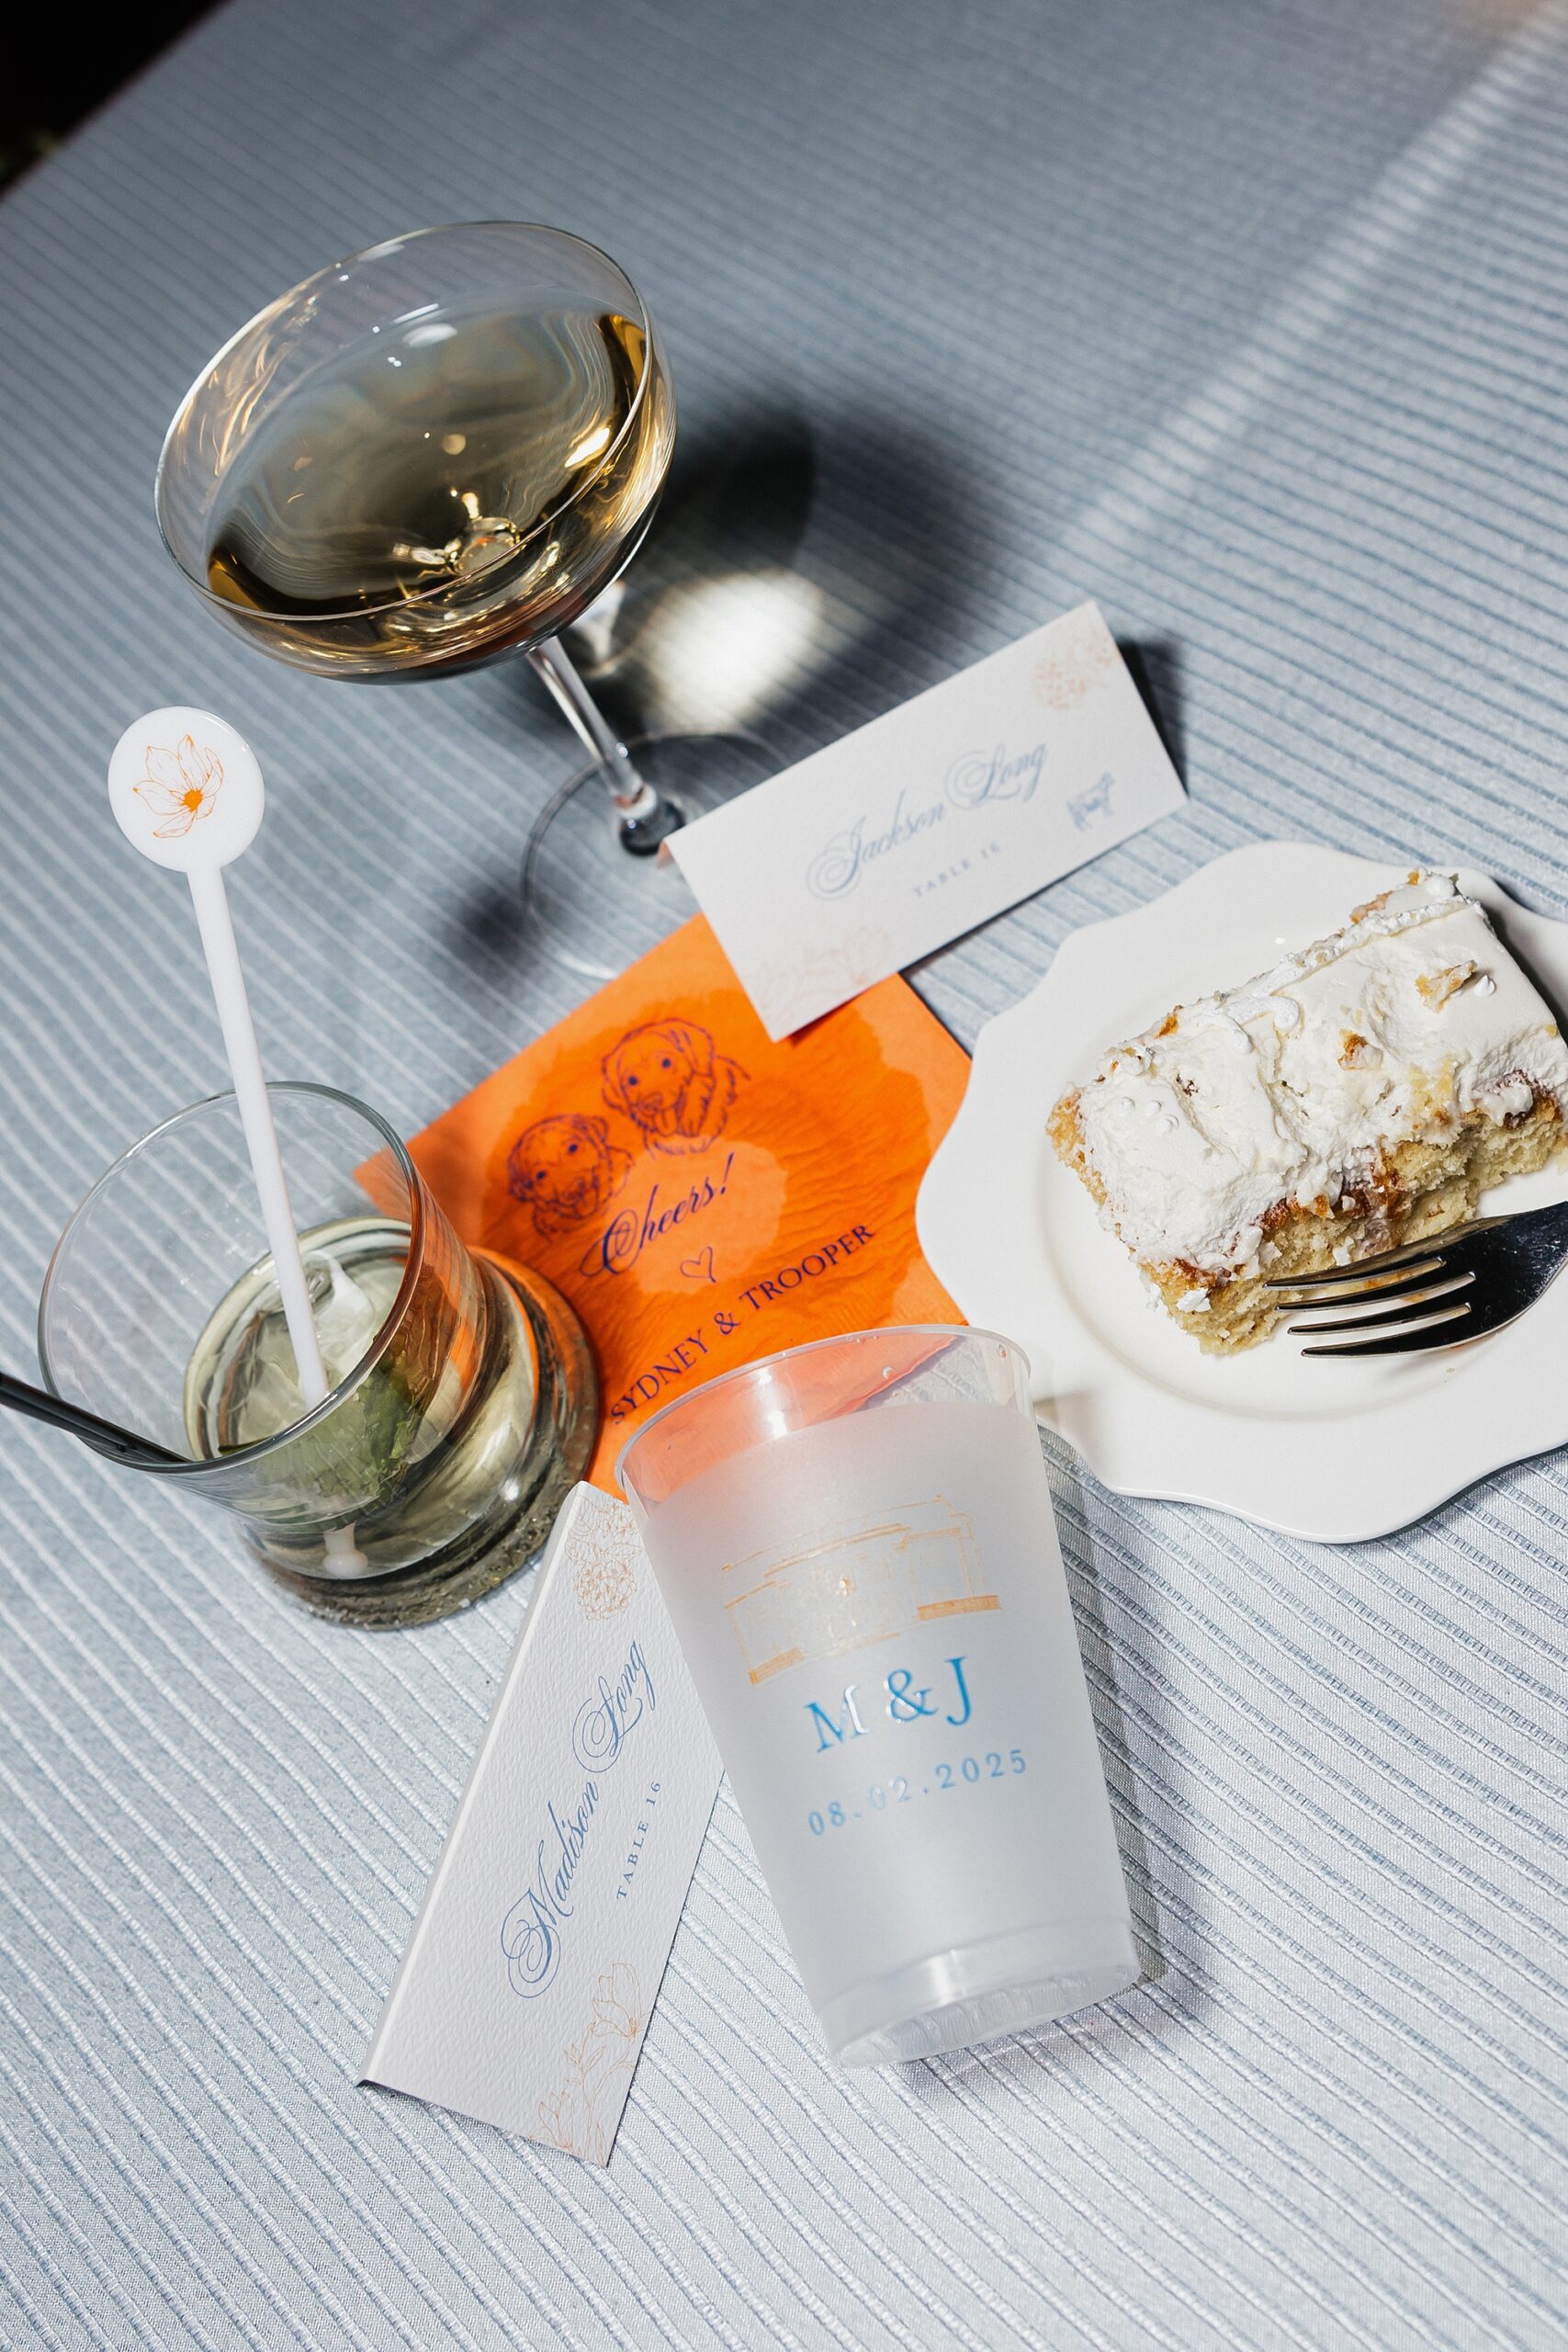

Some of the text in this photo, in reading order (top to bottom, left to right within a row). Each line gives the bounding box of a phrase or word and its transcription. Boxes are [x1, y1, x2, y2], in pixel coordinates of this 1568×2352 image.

[807, 742, 1048, 900] Jackson Long
[913, 843, 1000, 897] TABLE 16
[580, 1152, 734, 1277] Cheers!
[610, 1225, 874, 1424] SYDNEY & TROOPER
[804, 1656, 974, 1753] M & J
[501, 1640, 656, 1998] Madison Long
[616, 1781, 661, 1899] TABLE 16
[808, 1749, 1027, 1836] 08.02.2025
